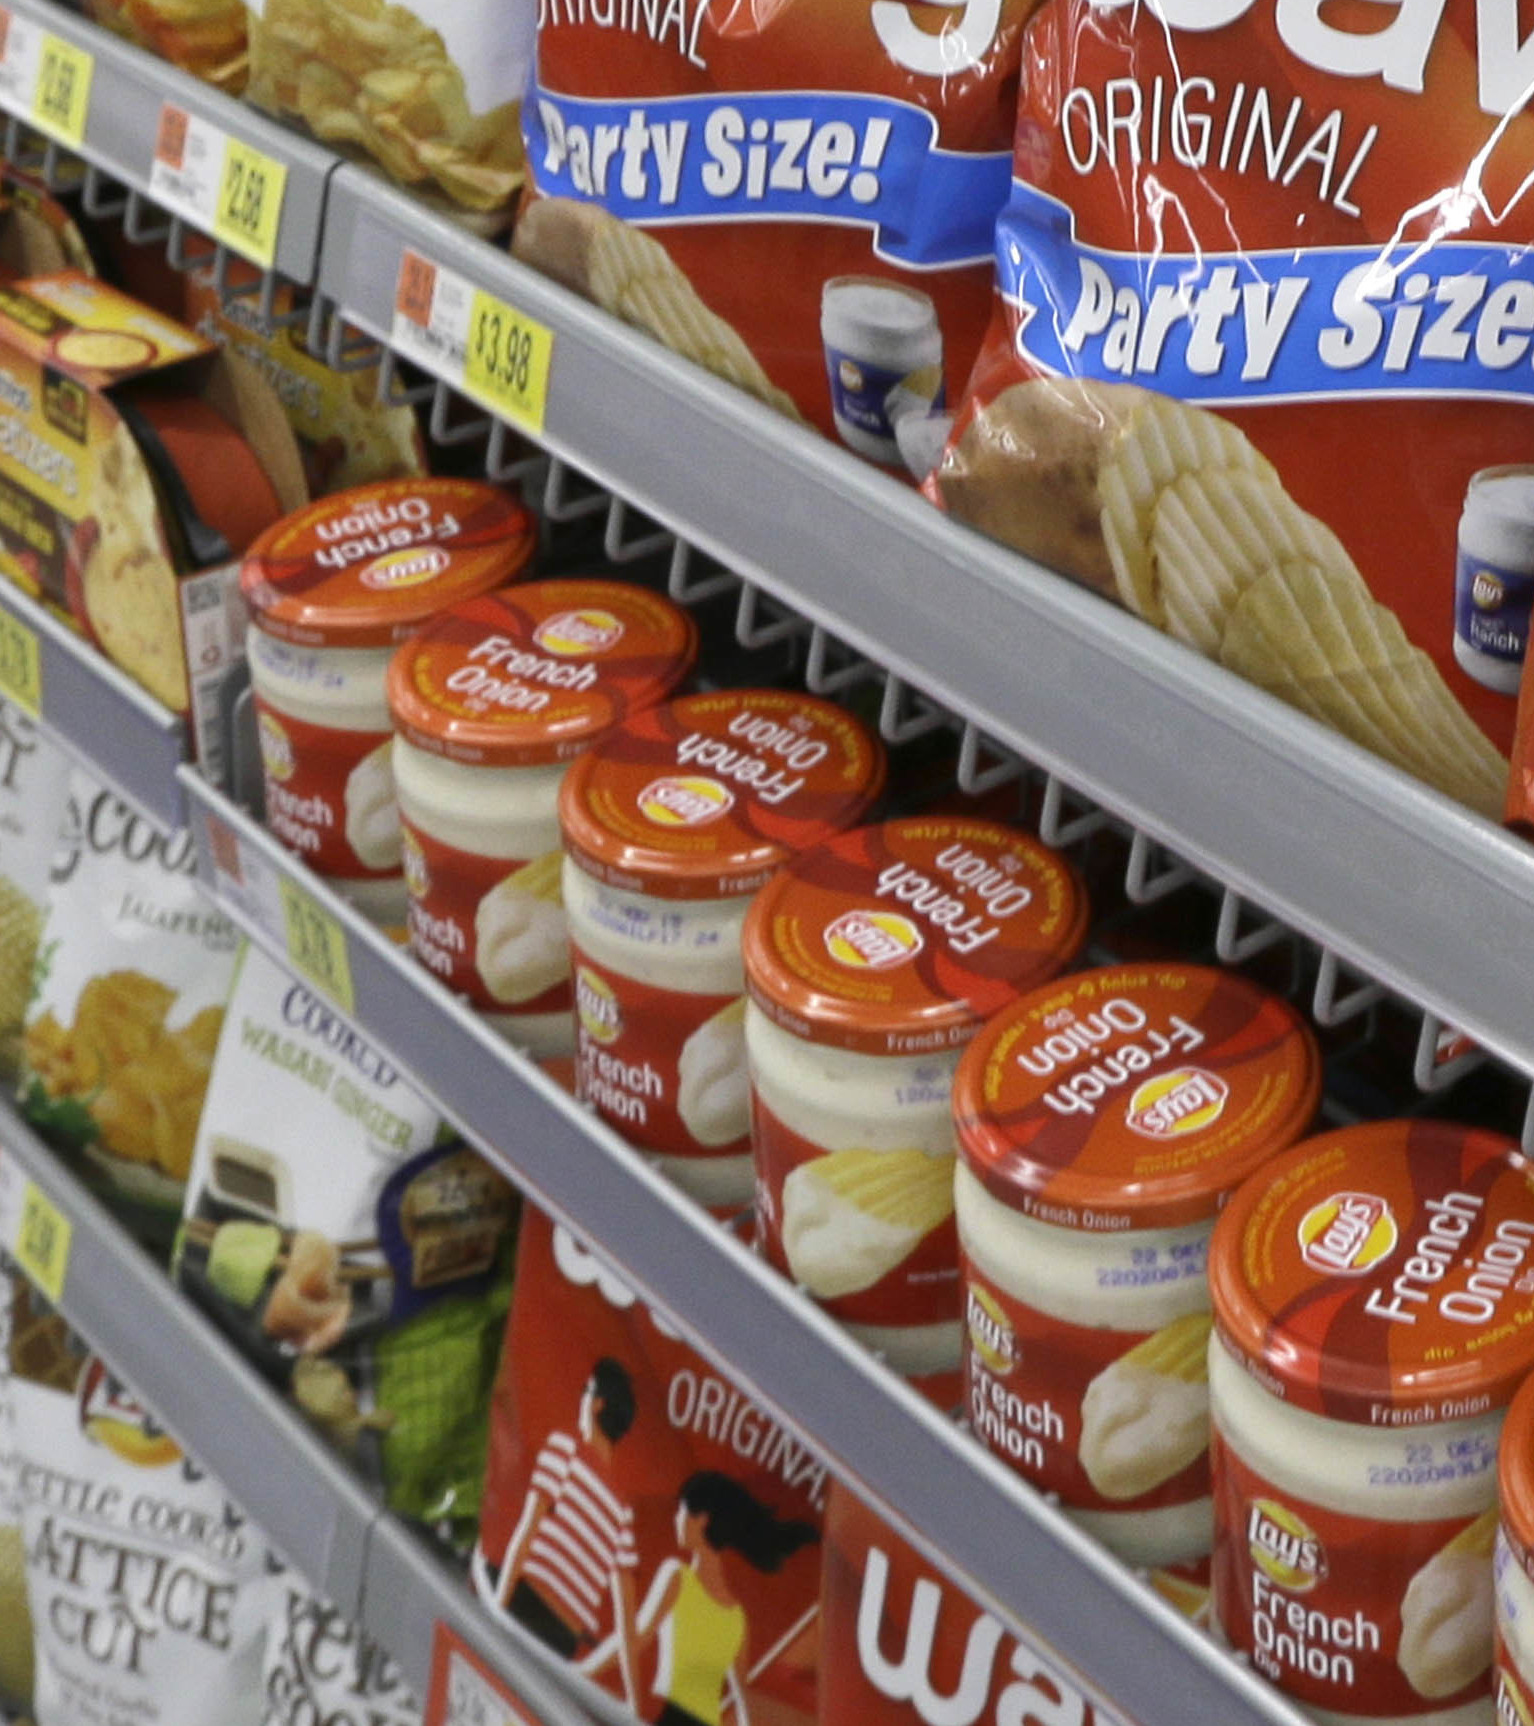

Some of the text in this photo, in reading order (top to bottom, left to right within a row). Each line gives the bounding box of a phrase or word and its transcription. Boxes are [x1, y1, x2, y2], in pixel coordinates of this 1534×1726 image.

[538, 99, 892, 205] Party Size!
[1061, 75, 1377, 218] ORIGINAL
[476, 311, 532, 394] $3.98
[1062, 258, 1309, 381] Party
[315, 513, 460, 568] French
[317, 498, 431, 541] Onion
[447, 667, 550, 712] Onion
[469, 637, 597, 691] French
[677, 732, 804, 805] French
[728, 710, 830, 772] Onion
[876, 862, 999, 955] French
[935, 841, 1033, 919] Onion
[1017, 997, 1148, 1075] Onion
[1043, 1016, 1205, 1116] French
[1023, 1195, 1132, 1230] French Onion
[1365, 1192, 1485, 1324] French
[971, 1350, 1064, 1442] French
[971, 1390, 1045, 1470] Onion
[1371, 1395, 1491, 1424] French Onion
[666, 1369, 828, 1513] ORIGINA
[1248, 1508, 1321, 1573] Lay's
[32, 1517, 238, 1652] ATTICE
[1253, 1571, 1380, 1652] French
[857, 1547, 1091, 1726] wa
[1253, 1612, 1355, 1687] Onion
